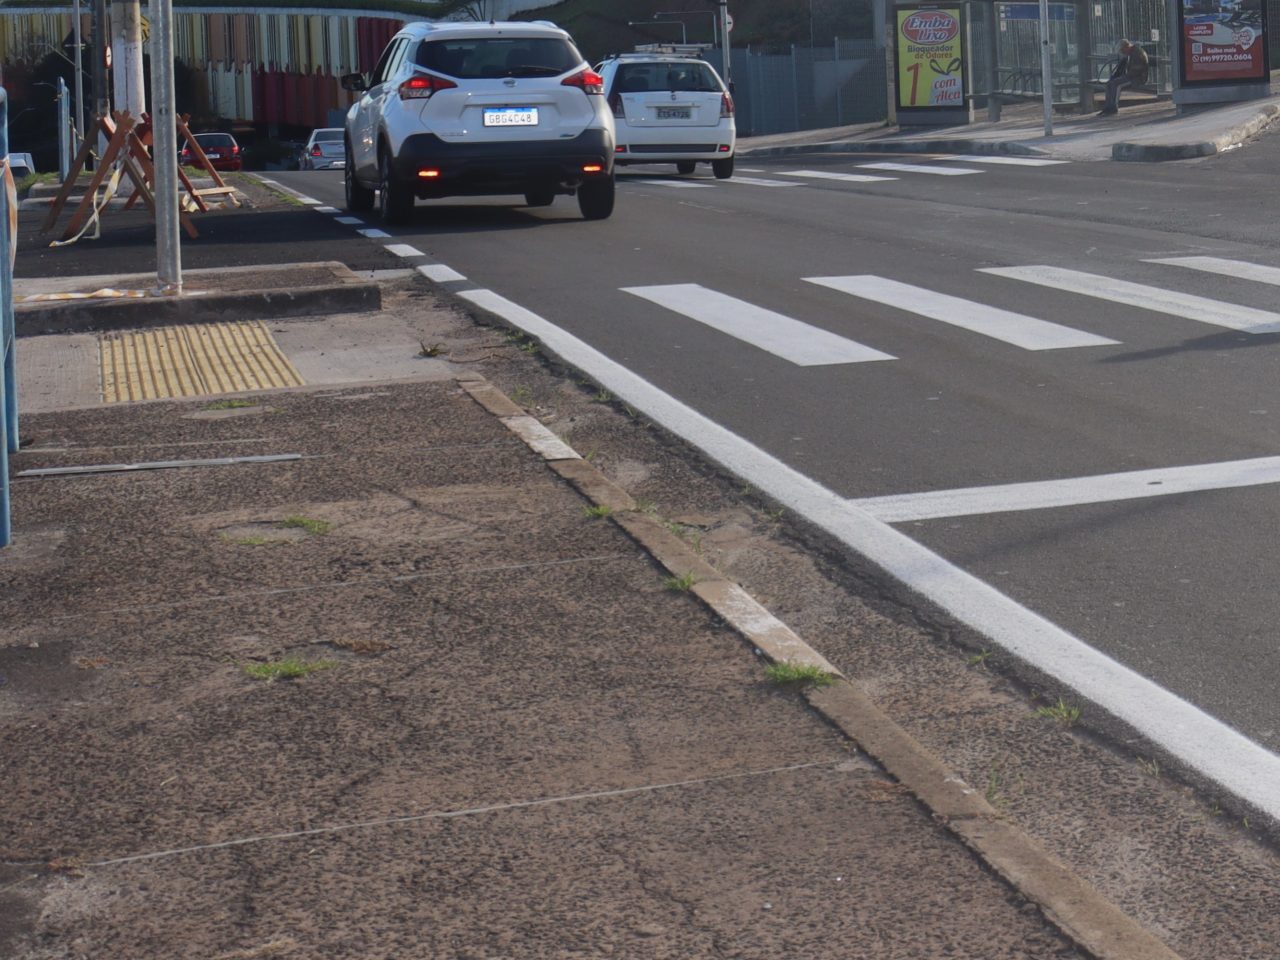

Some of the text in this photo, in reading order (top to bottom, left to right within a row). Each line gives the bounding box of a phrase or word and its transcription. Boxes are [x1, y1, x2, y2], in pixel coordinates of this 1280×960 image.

[909, 16, 952, 29] Emba
[907, 45, 953, 54] Bloqueador
[934, 78, 956, 89] com
